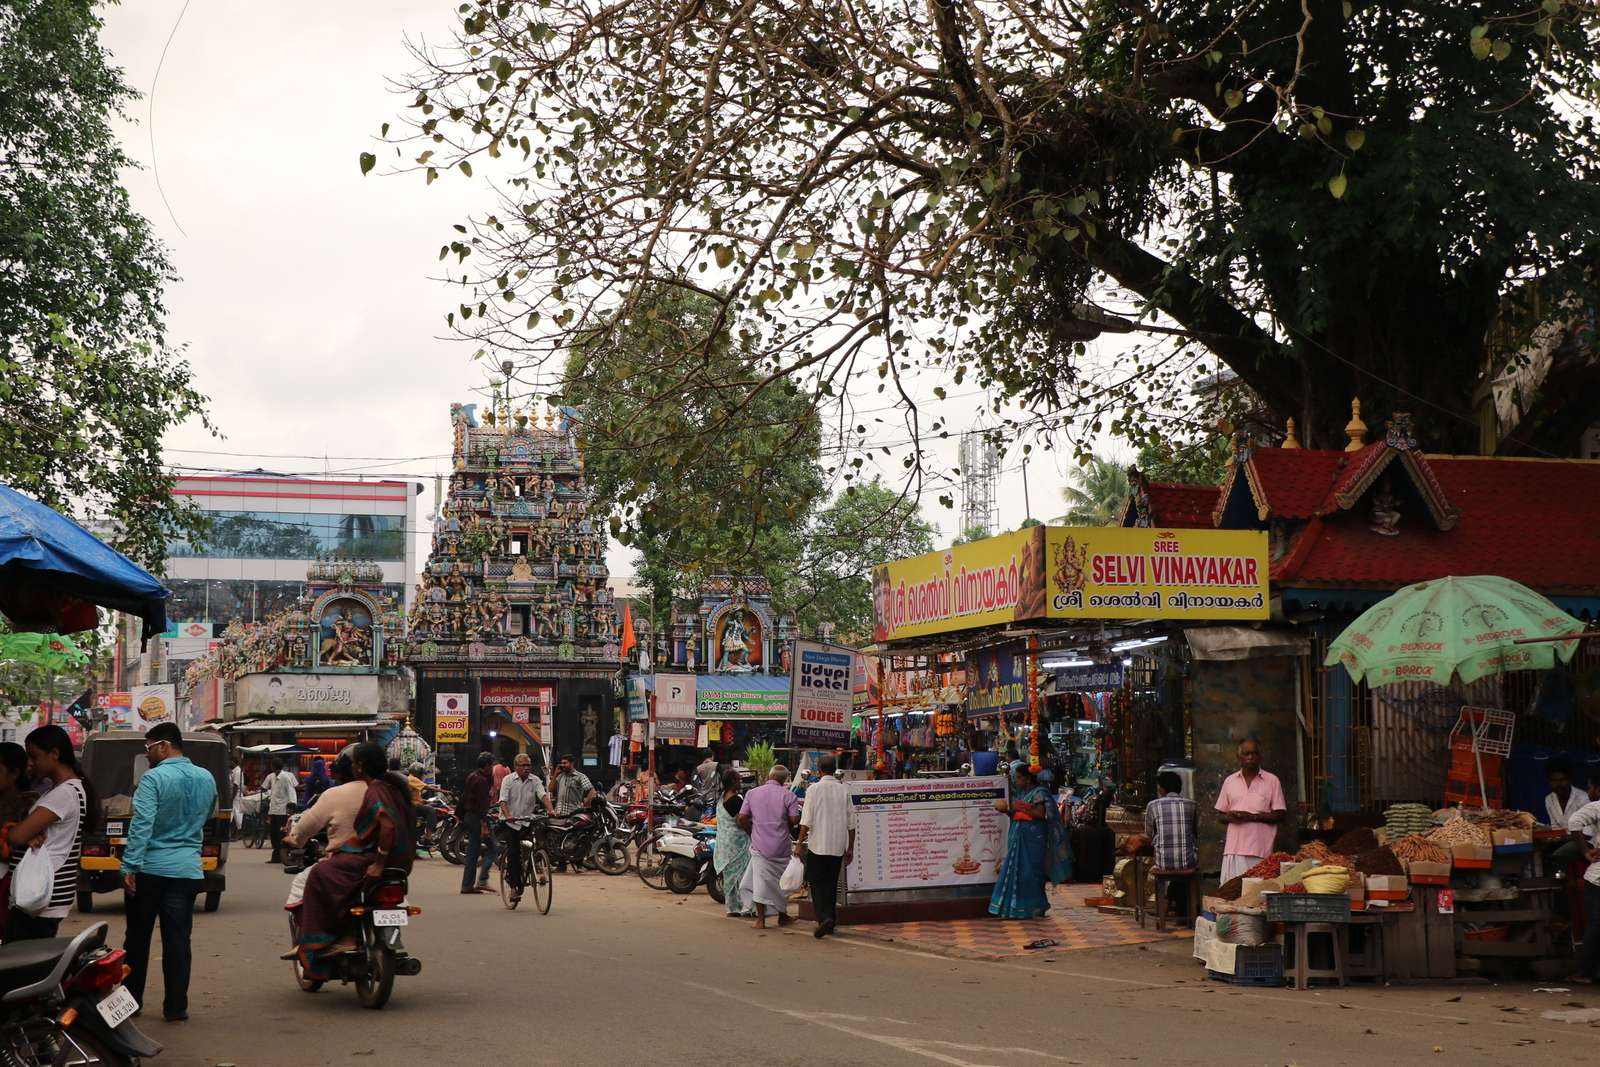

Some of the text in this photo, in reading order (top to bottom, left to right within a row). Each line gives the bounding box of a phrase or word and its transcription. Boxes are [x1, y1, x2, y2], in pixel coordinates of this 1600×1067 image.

[1153, 541, 1180, 553] SREE
[1092, 555, 1258, 585] SELVI VINAYAKAR
[886, 558, 1018, 636] ശ്രീ ശെൽവി വിനായകർ
[1053, 591, 1264, 609] ശ്രീ ശെൽവി വിനായകർ
[801, 663, 850, 681] Udupi
[800, 675, 849, 691] Hotel
[800, 709, 844, 723] LODGE
